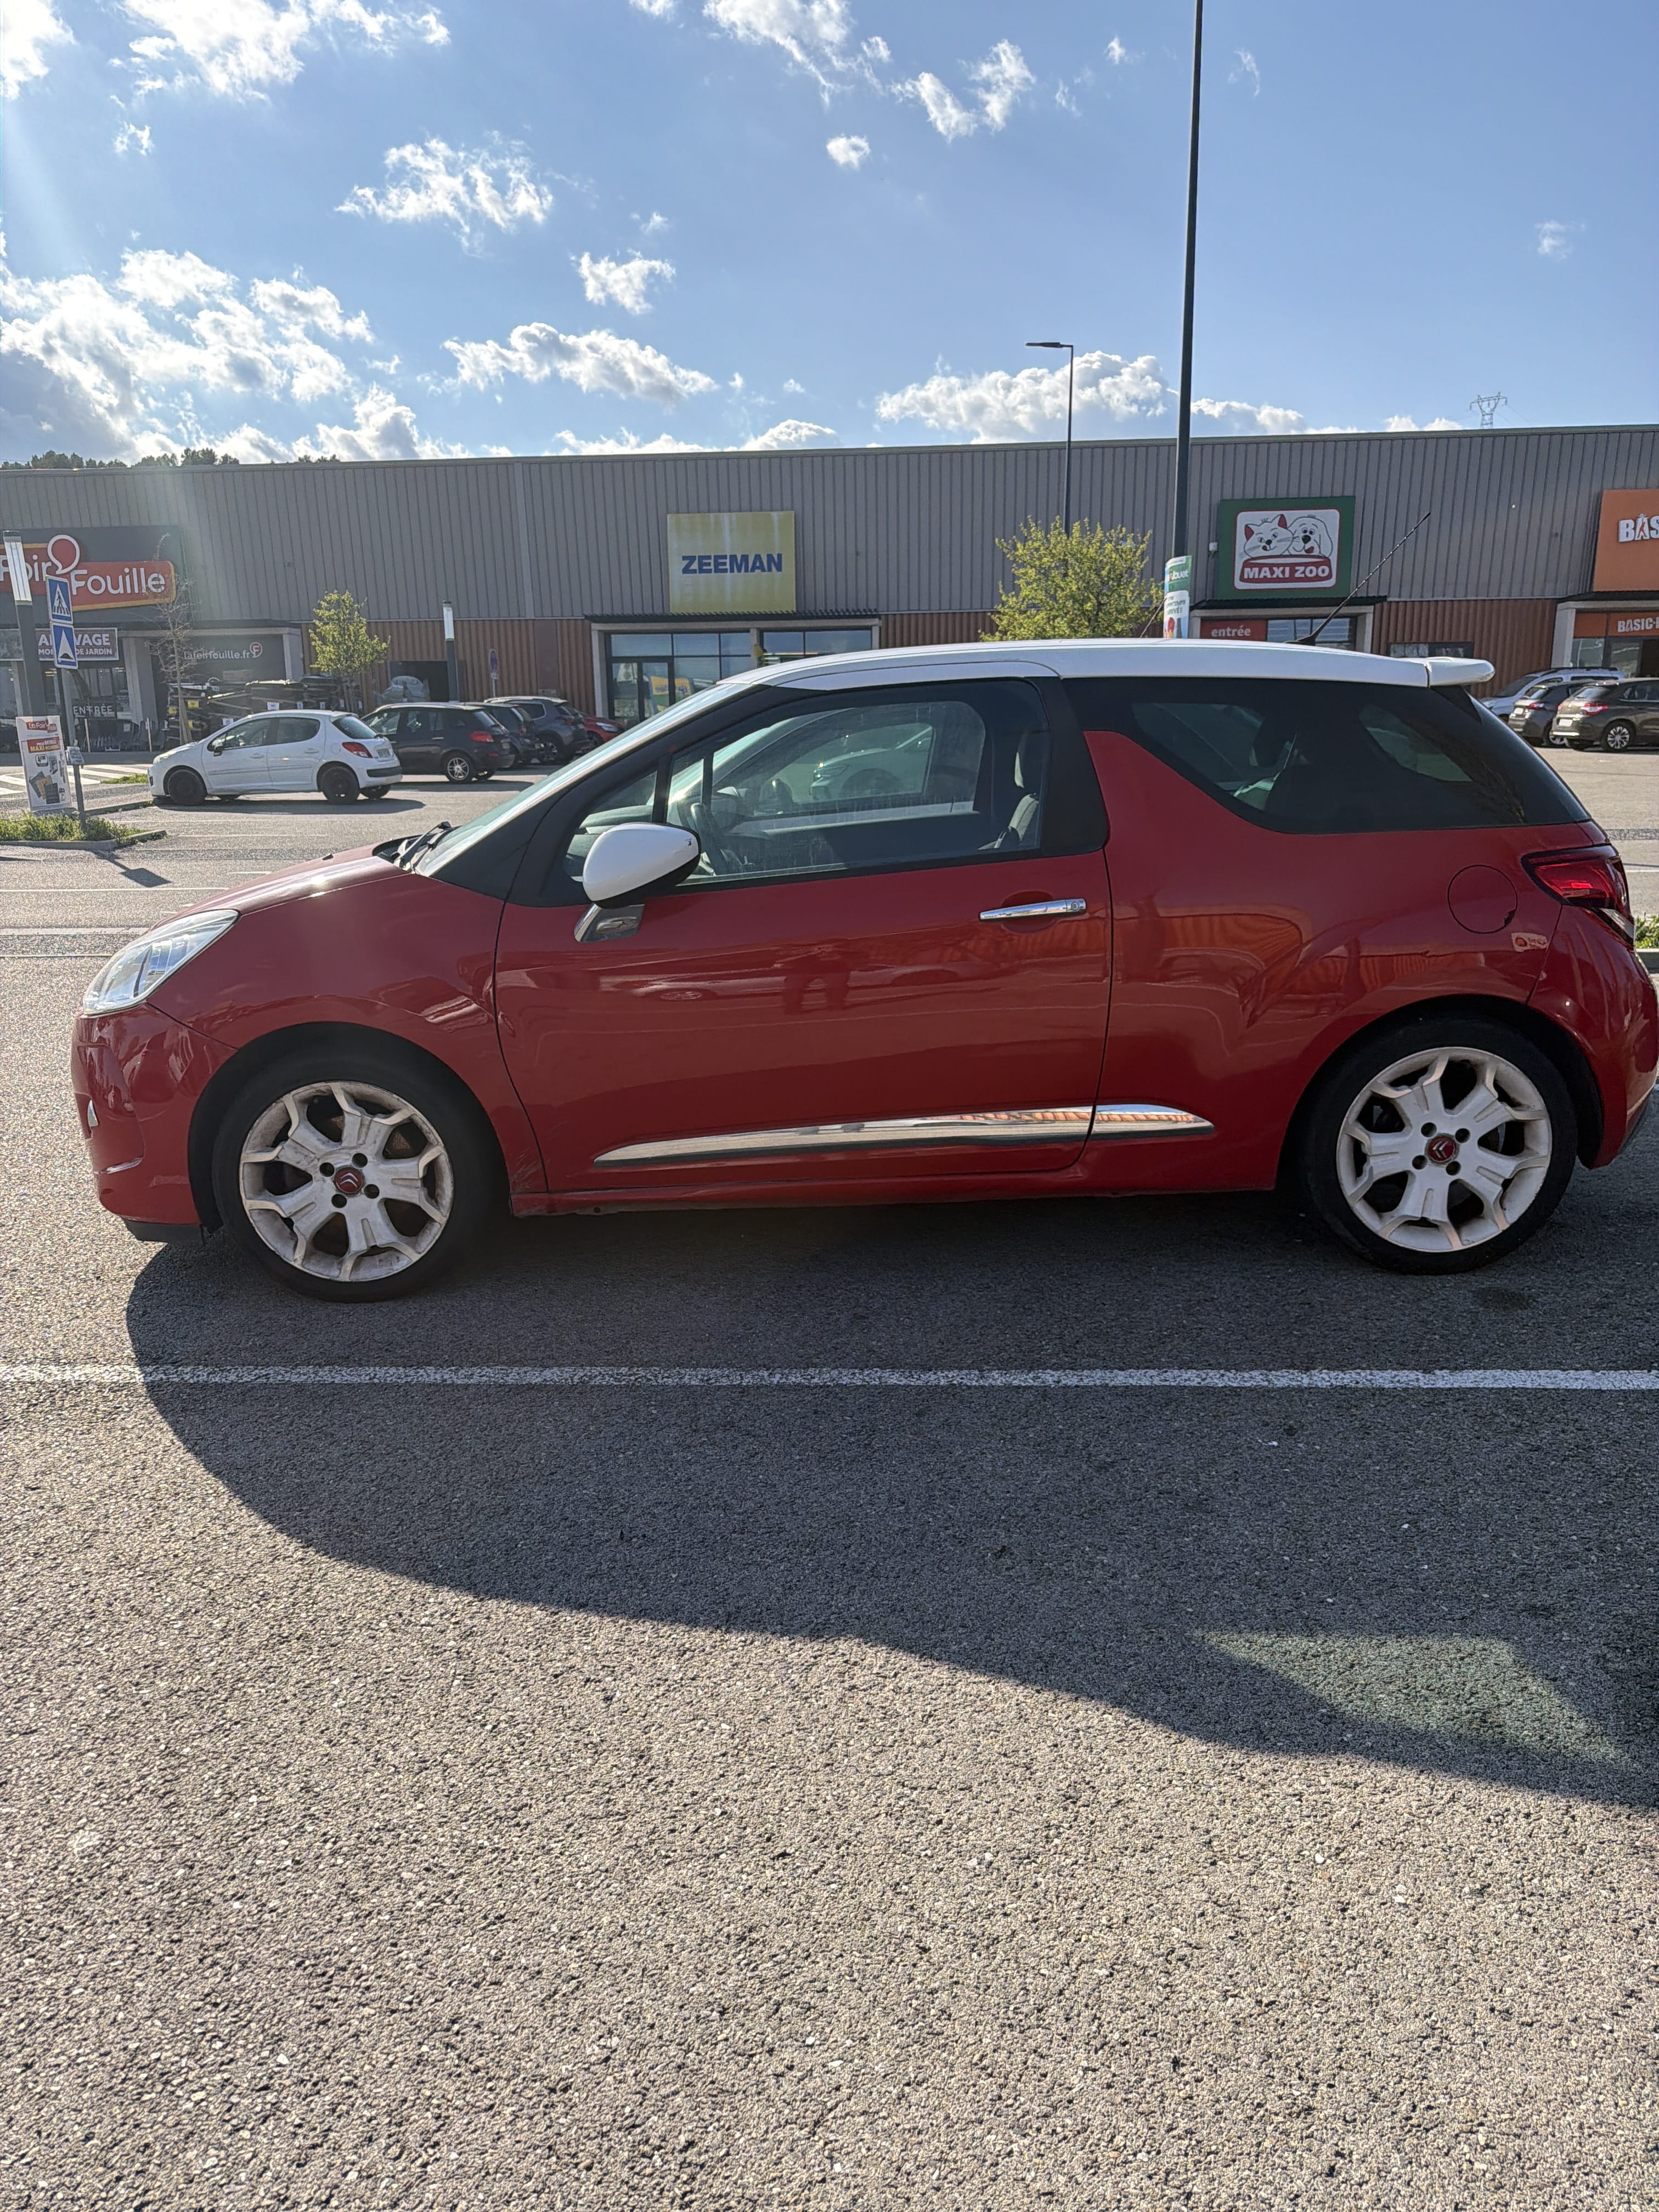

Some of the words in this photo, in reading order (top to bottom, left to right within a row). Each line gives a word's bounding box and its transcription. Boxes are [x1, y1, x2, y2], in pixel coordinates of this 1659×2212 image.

[681, 553, 782, 574] ZEEMAN
[1244, 567, 1290, 579] MAXI
[1295, 565, 1330, 578] ZOO
[70, 567, 165, 595] Fouille
[1211, 624, 1251, 637] entrée
[73, 703, 112, 715] ENTRÉE
